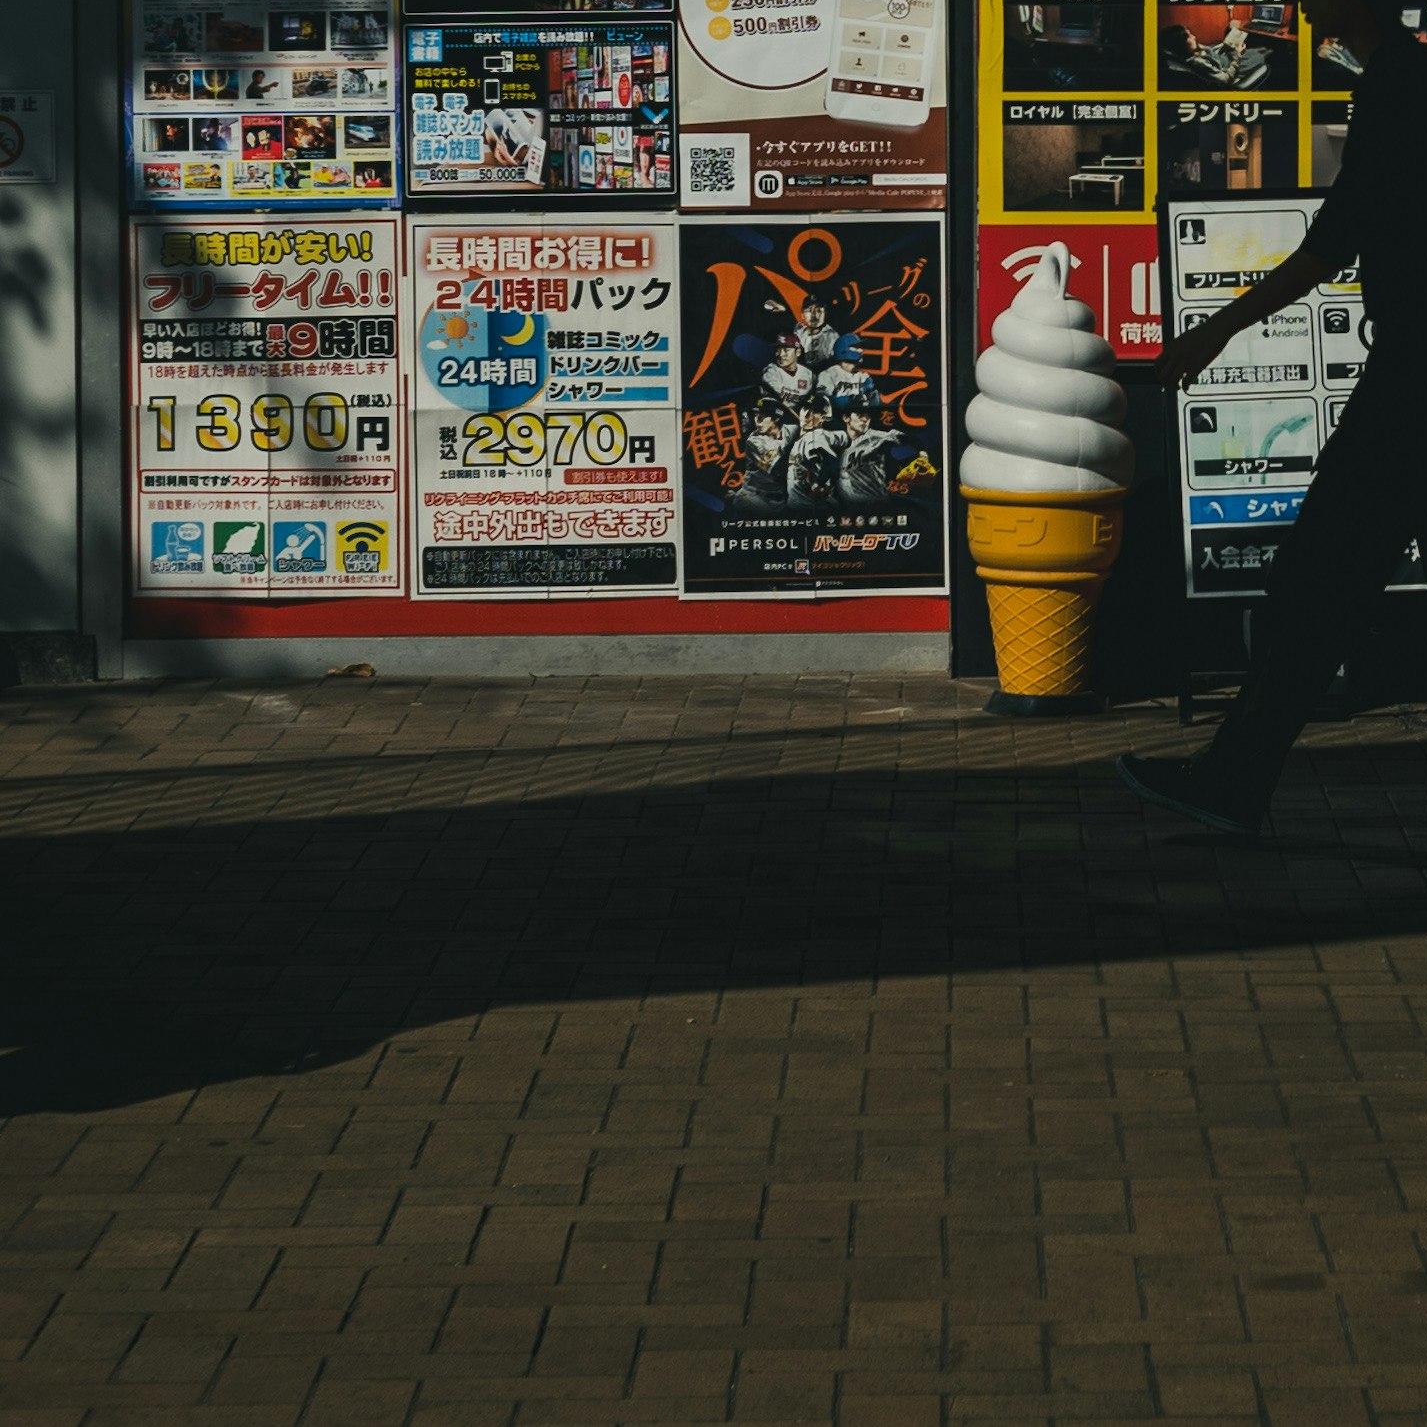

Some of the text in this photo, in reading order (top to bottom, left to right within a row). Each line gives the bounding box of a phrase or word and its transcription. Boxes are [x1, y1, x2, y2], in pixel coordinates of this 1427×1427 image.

[733, 15, 821, 36] 500円割引券
[1010, 106, 1064, 119] ロイヤル
[1177, 103, 1282, 123] ランドリー
[416, 138, 481, 161] 読み放題
[162, 230, 373, 266] 長時間が安い!
[427, 236, 650, 271] 長時間お得に!
[144, 269, 393, 312] フリータイム!!
[436, 278, 671, 312] 24時間パック
[1271, 313, 1307, 325] iPhone
[143, 322, 261, 338] 早い入店ほどお得!
[288, 319, 396, 358] 9時間
[547, 330, 659, 351] 雑誌コミック
[1271, 328, 1308, 338] Android
[441, 358, 537, 385] 24時間
[550, 356, 659, 374] ドリンクバー
[548, 382, 623, 400] シャワー
[1224, 460, 1283, 475] シャワー
[434, 509, 675, 542] 途中外出もできます
[729, 538, 798, 550] PERSOL
